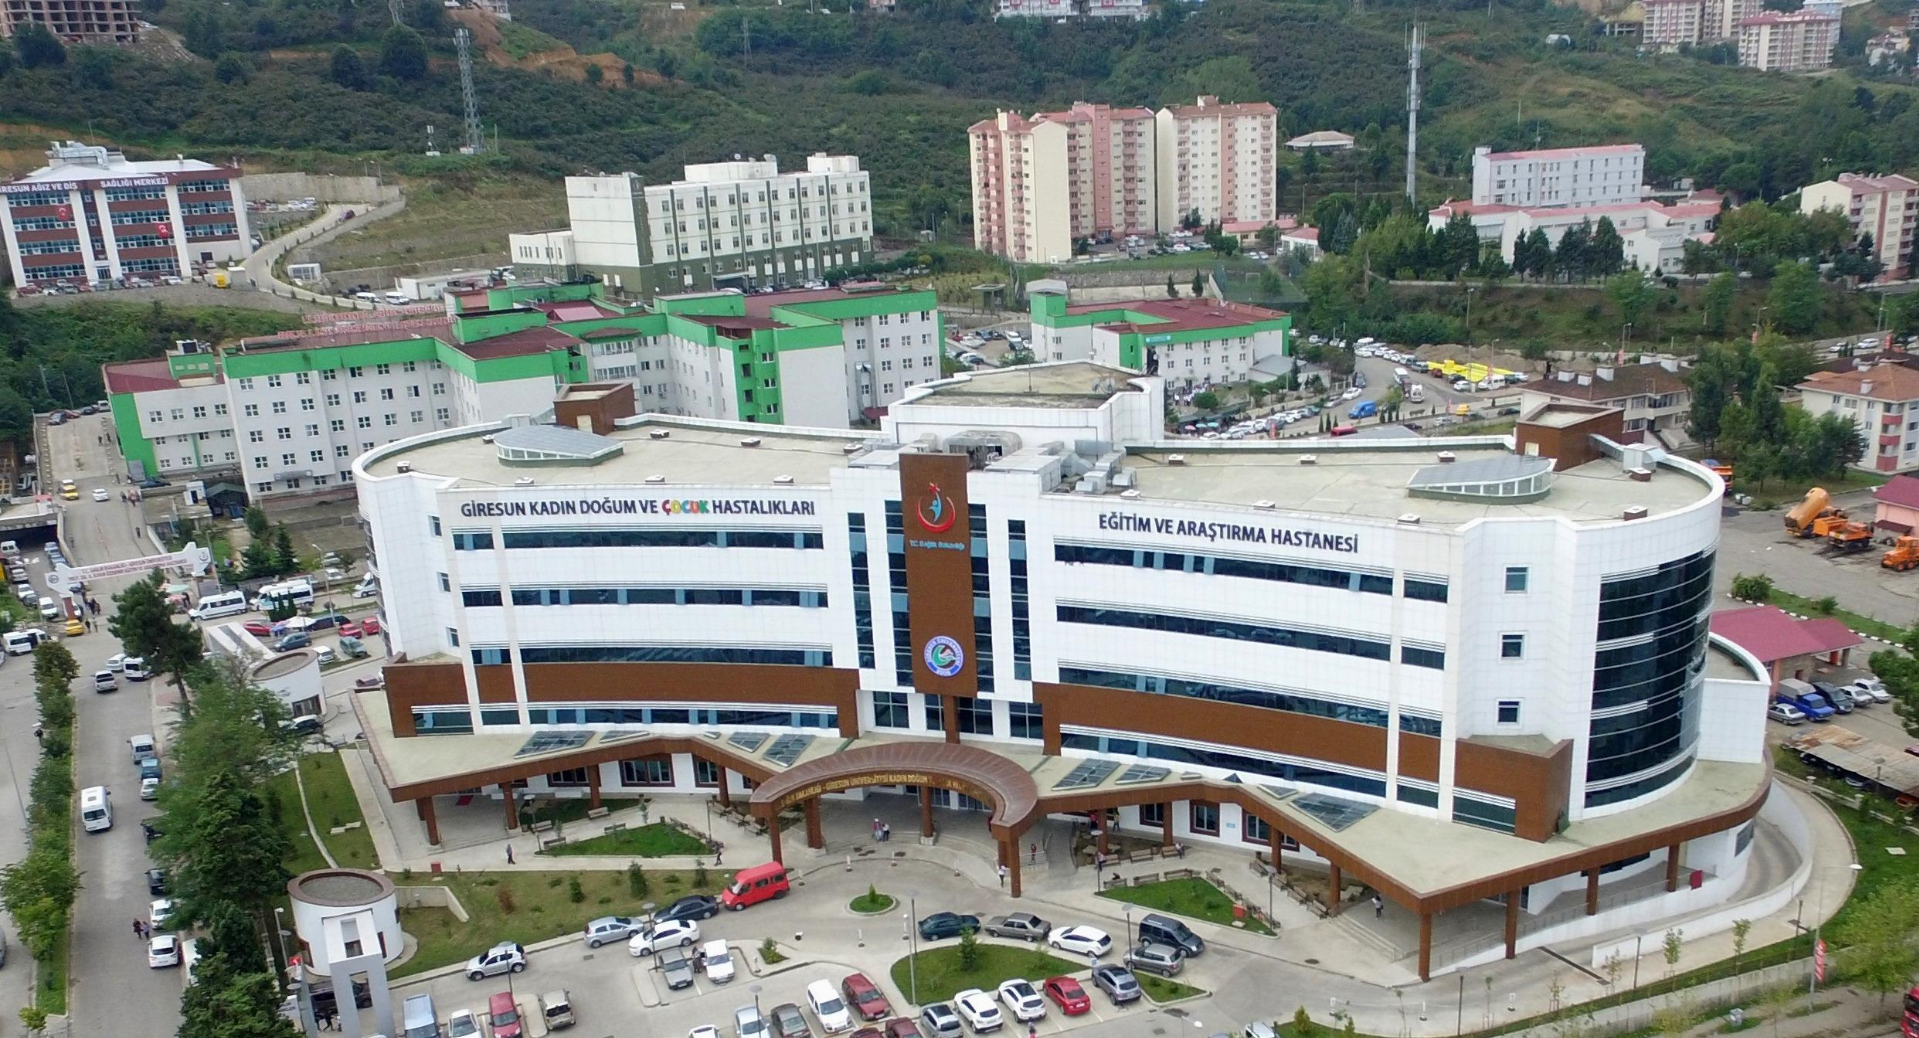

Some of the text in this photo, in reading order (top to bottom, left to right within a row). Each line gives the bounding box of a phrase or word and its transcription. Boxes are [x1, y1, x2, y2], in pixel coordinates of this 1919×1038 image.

[51, 183, 63, 191] VE
[134, 176, 169, 187] MERKEZİ
[460, 496, 816, 517] GİRESUN KADIN DOĞUM VE ÇOCUK HASTALIKLARI
[1099, 511, 1359, 554] EĞİTİM VE ARAŞTIRMA HASTANESİ
